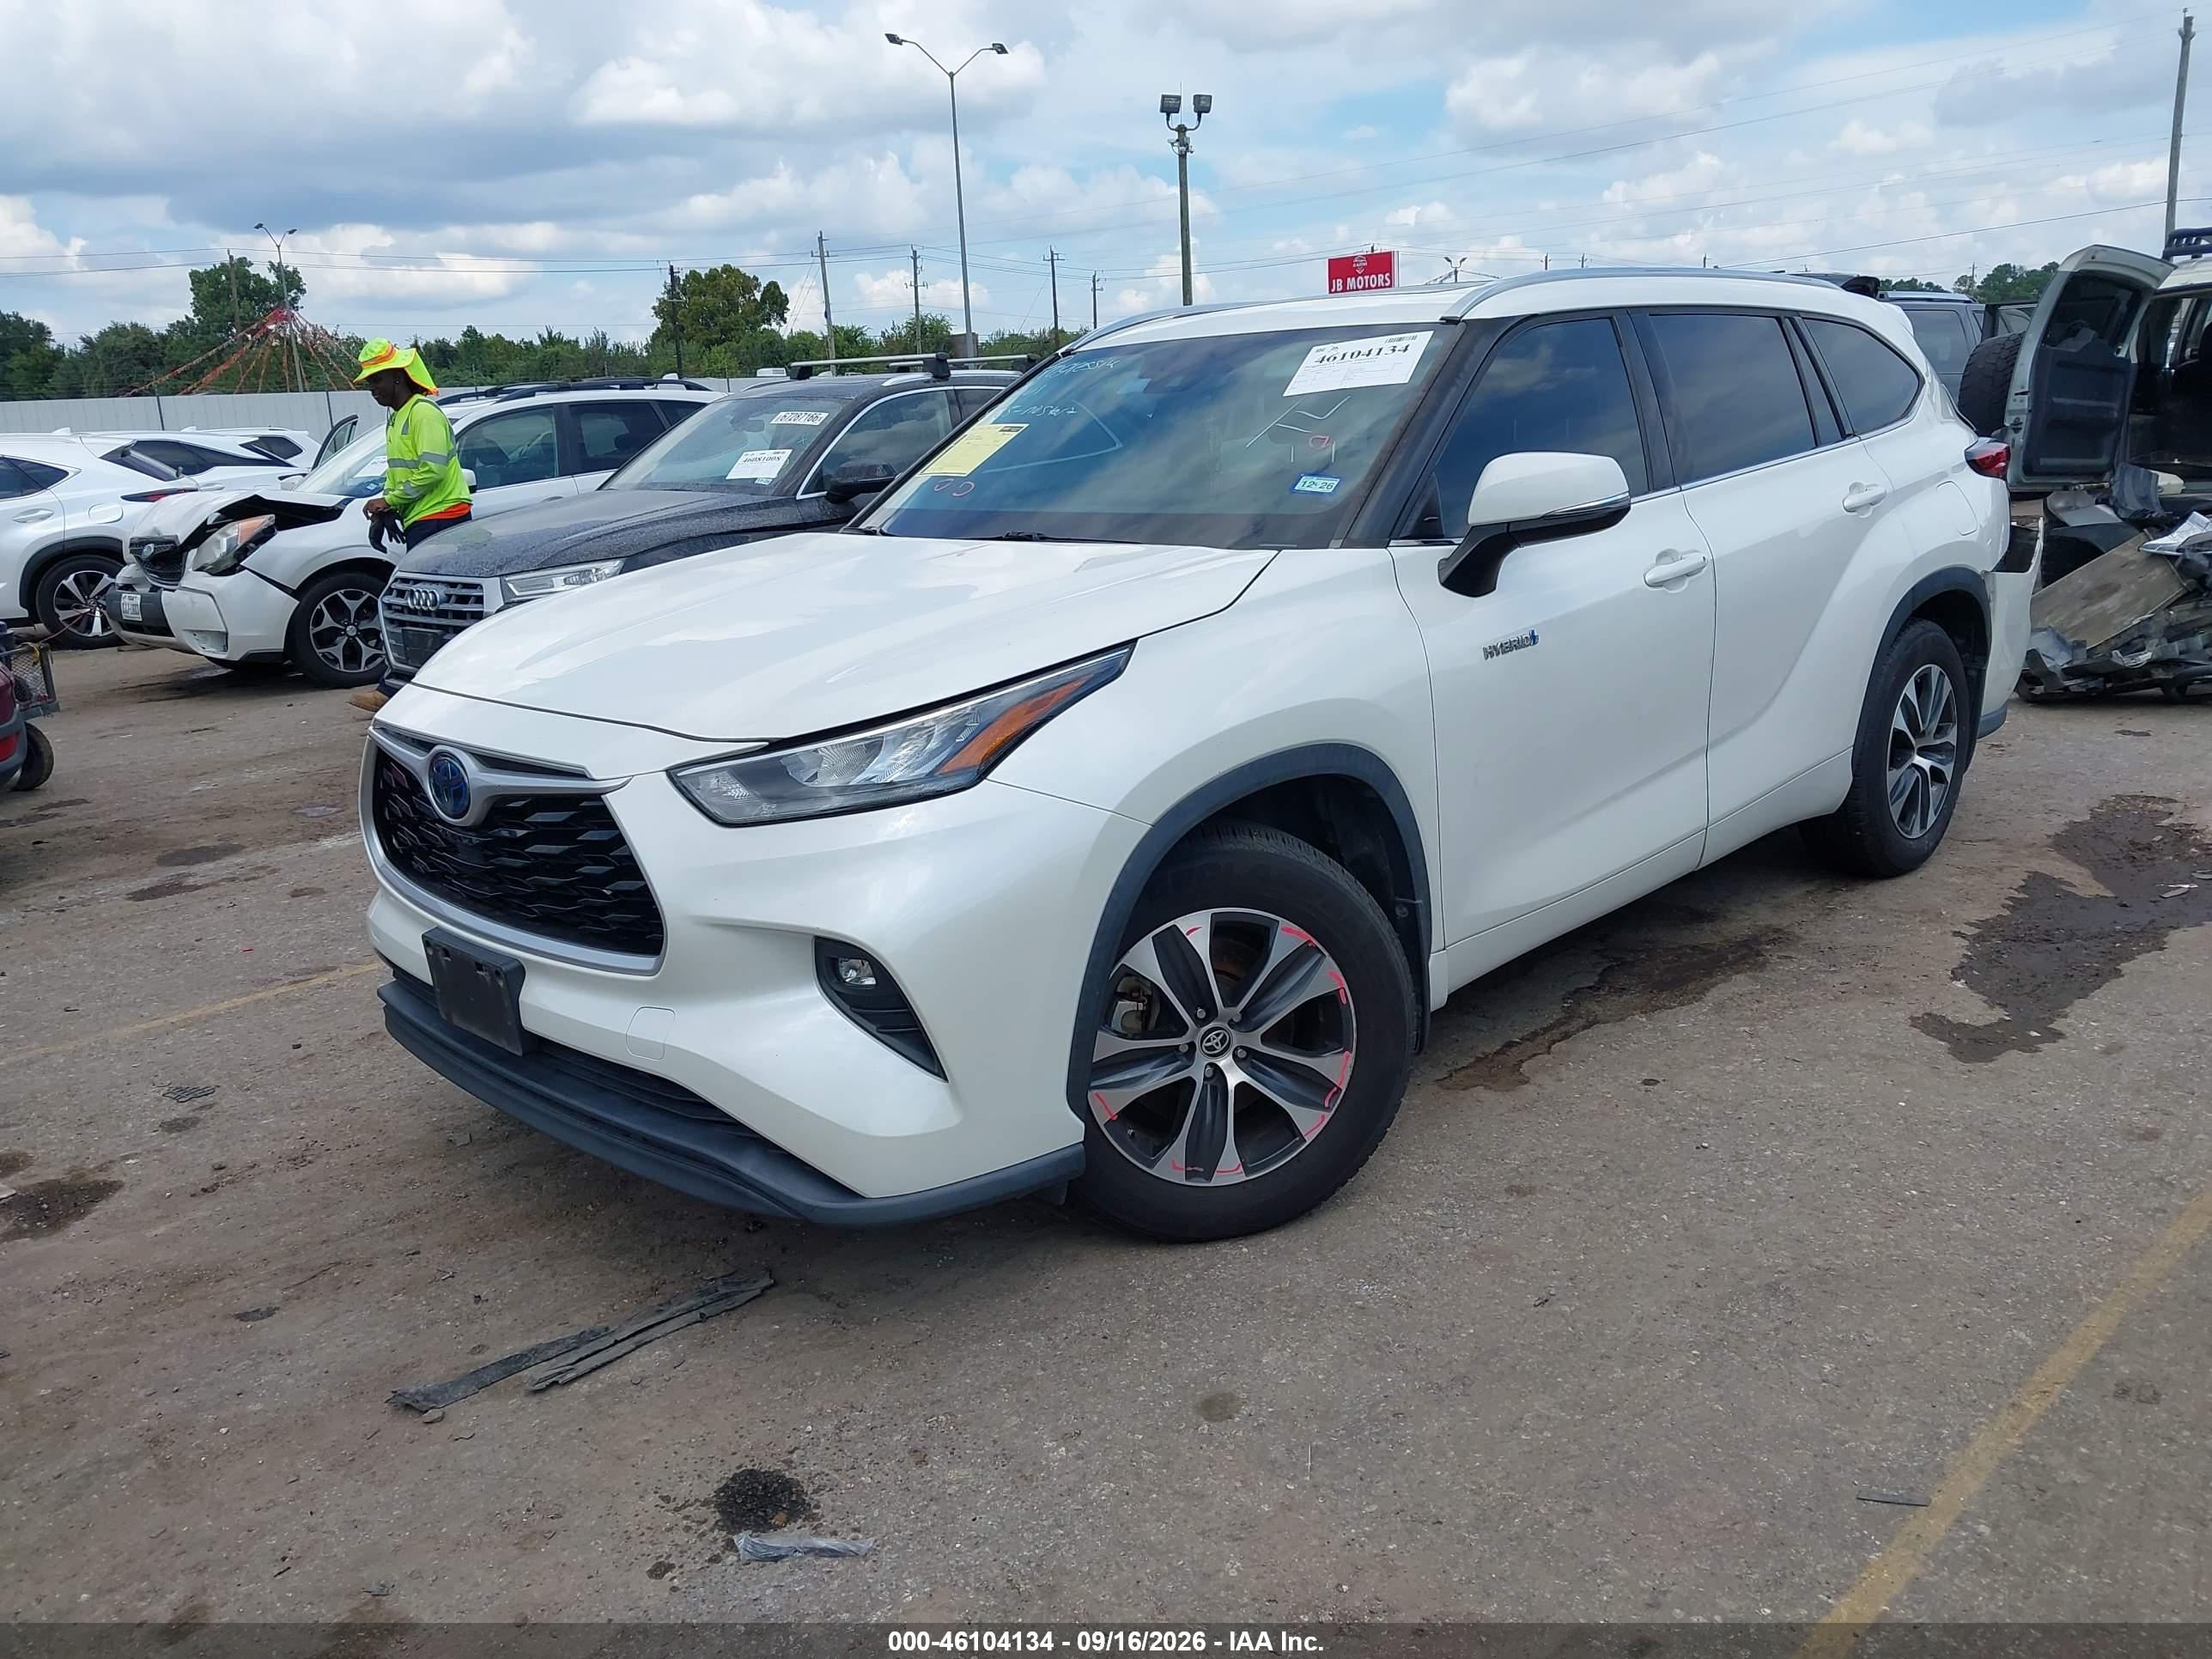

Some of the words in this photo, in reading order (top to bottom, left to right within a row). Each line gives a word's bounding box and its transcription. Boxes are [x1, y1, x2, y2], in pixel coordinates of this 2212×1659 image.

[1331, 278, 1343, 292] JB
[1346, 273, 1391, 290] MOTORS
[1315, 343, 1411, 364] 46104134
